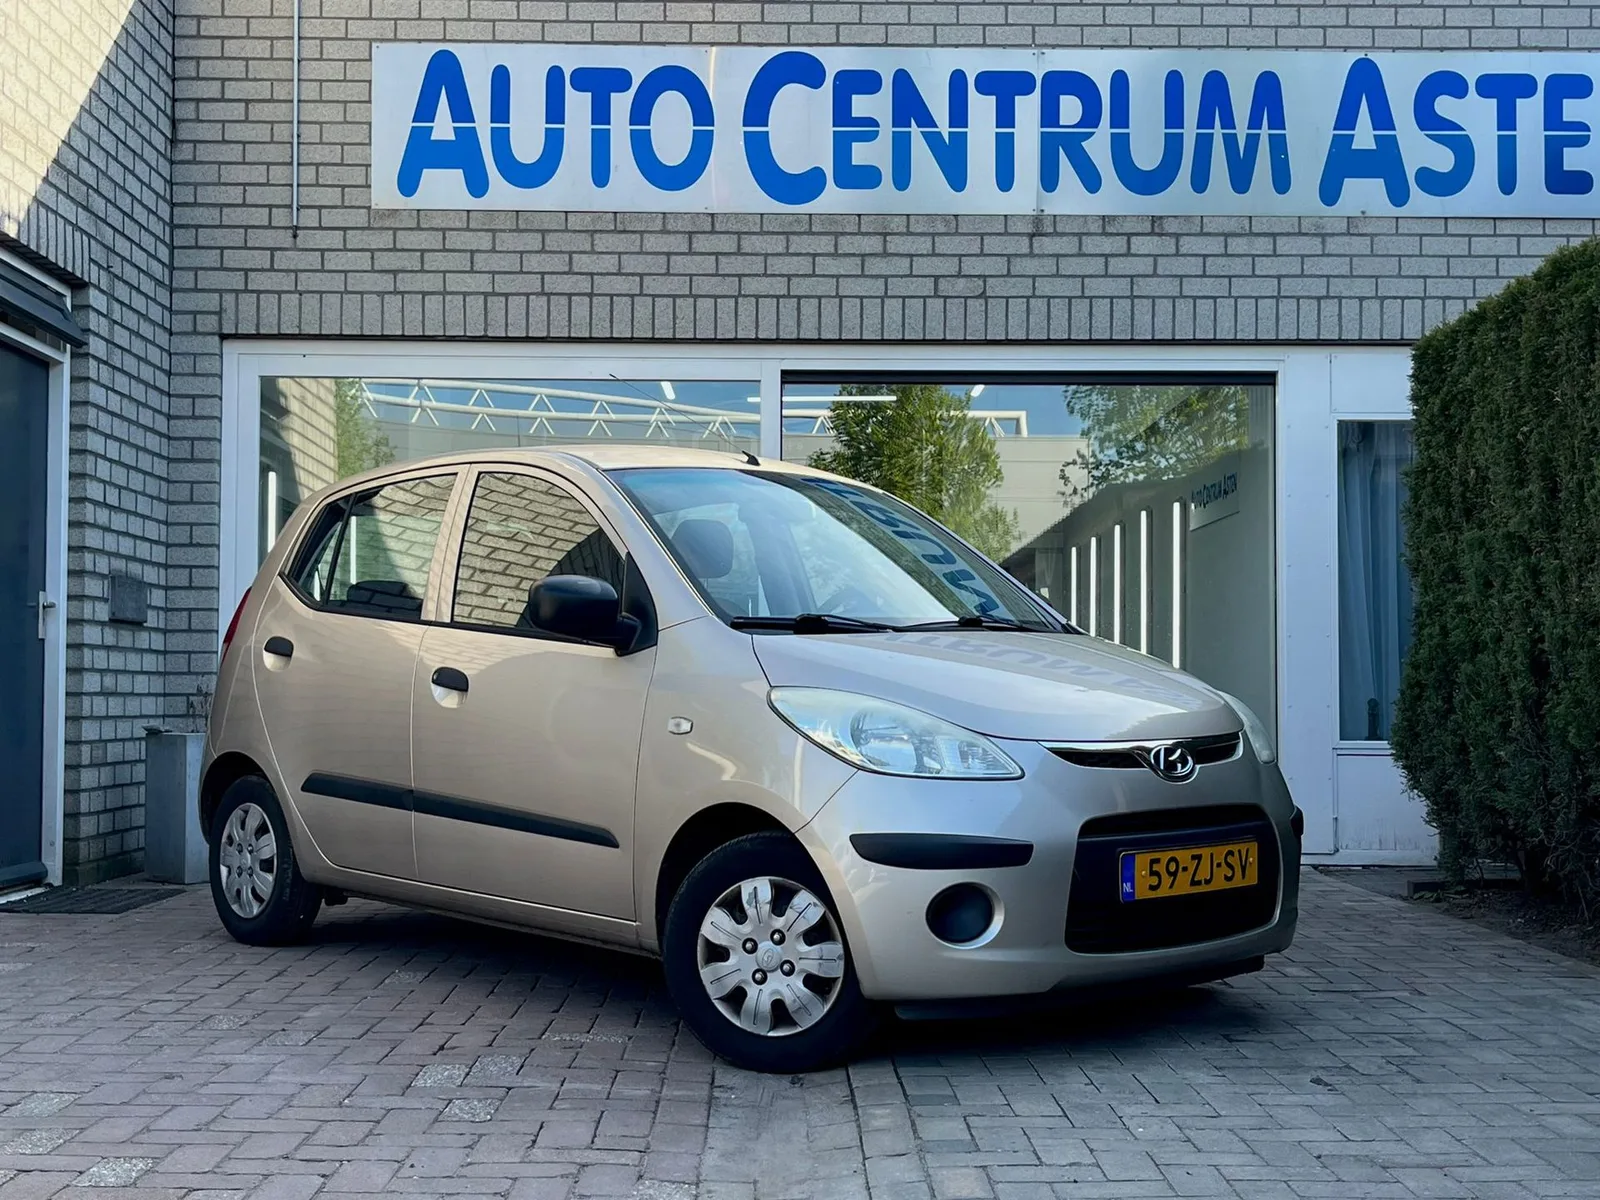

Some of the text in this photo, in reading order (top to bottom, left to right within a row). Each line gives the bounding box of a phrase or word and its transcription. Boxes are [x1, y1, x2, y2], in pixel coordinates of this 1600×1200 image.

[397, 49, 1594, 208] AUTO CENTRUM ASTE
[1123, 882, 1134, 893] NL
[1148, 847, 1250, 892] 59-ZJ-SV
